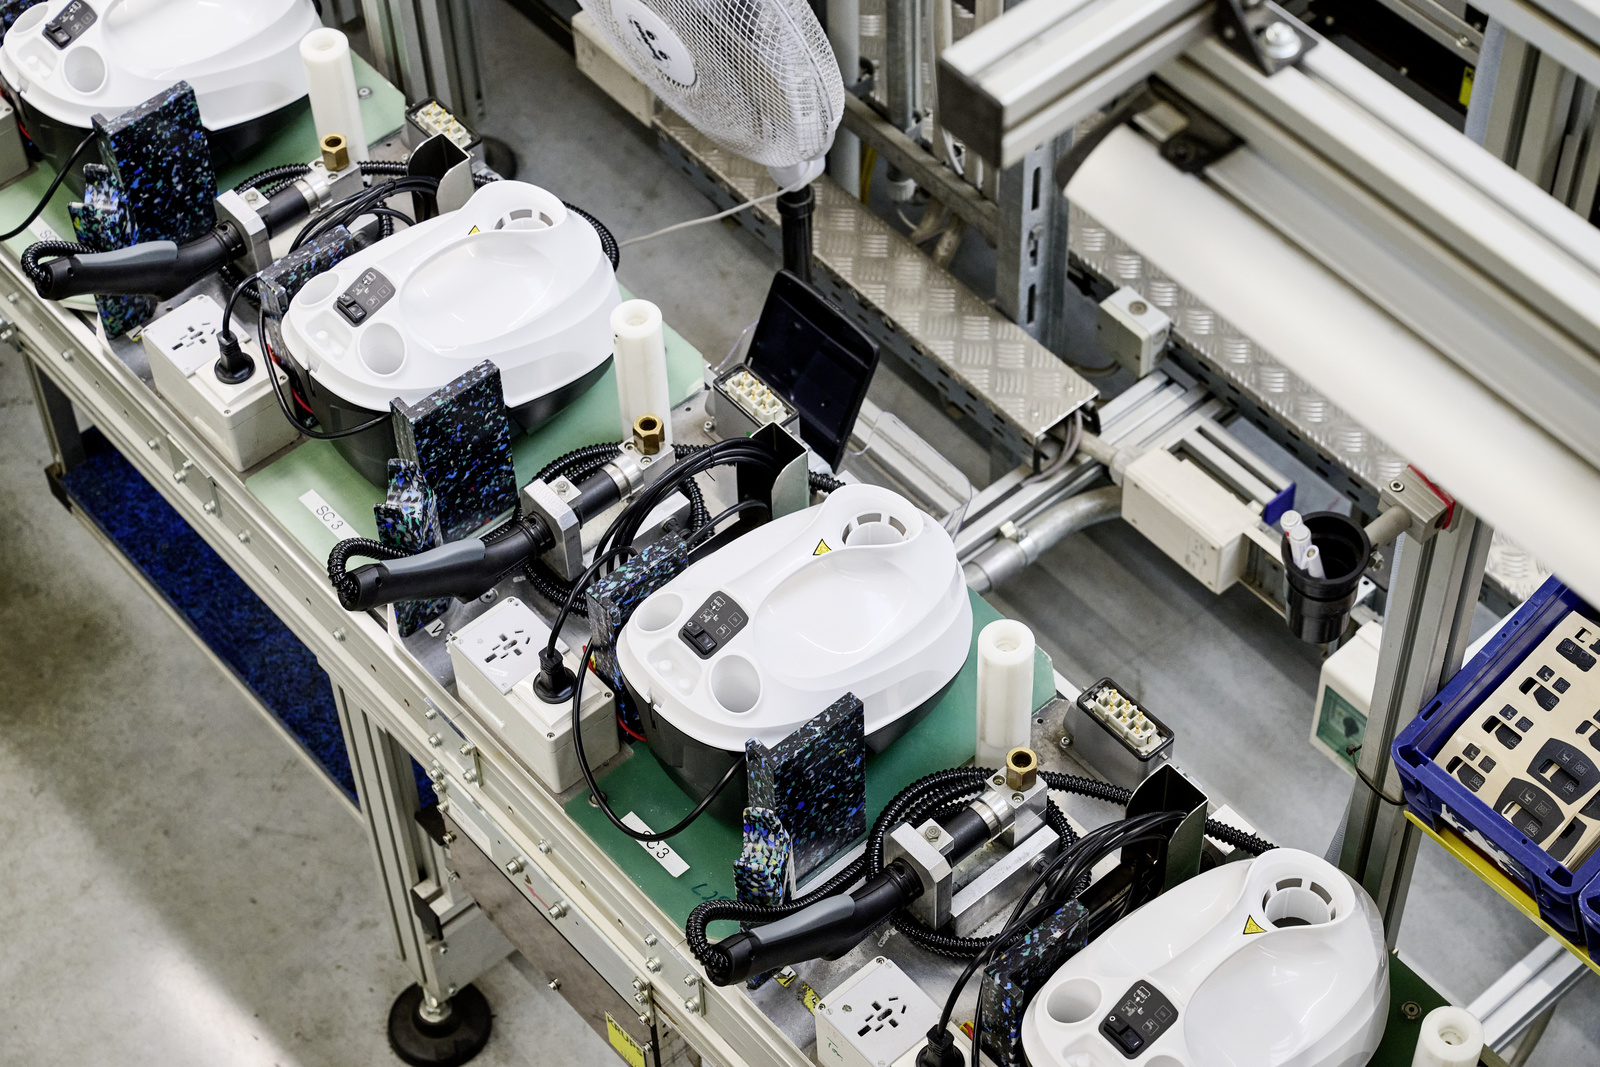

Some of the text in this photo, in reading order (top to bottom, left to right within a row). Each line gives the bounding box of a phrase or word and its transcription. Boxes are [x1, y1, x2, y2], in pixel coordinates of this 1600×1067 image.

[316, 505, 344, 530] SC 3
[656, 847, 670, 859] 3
